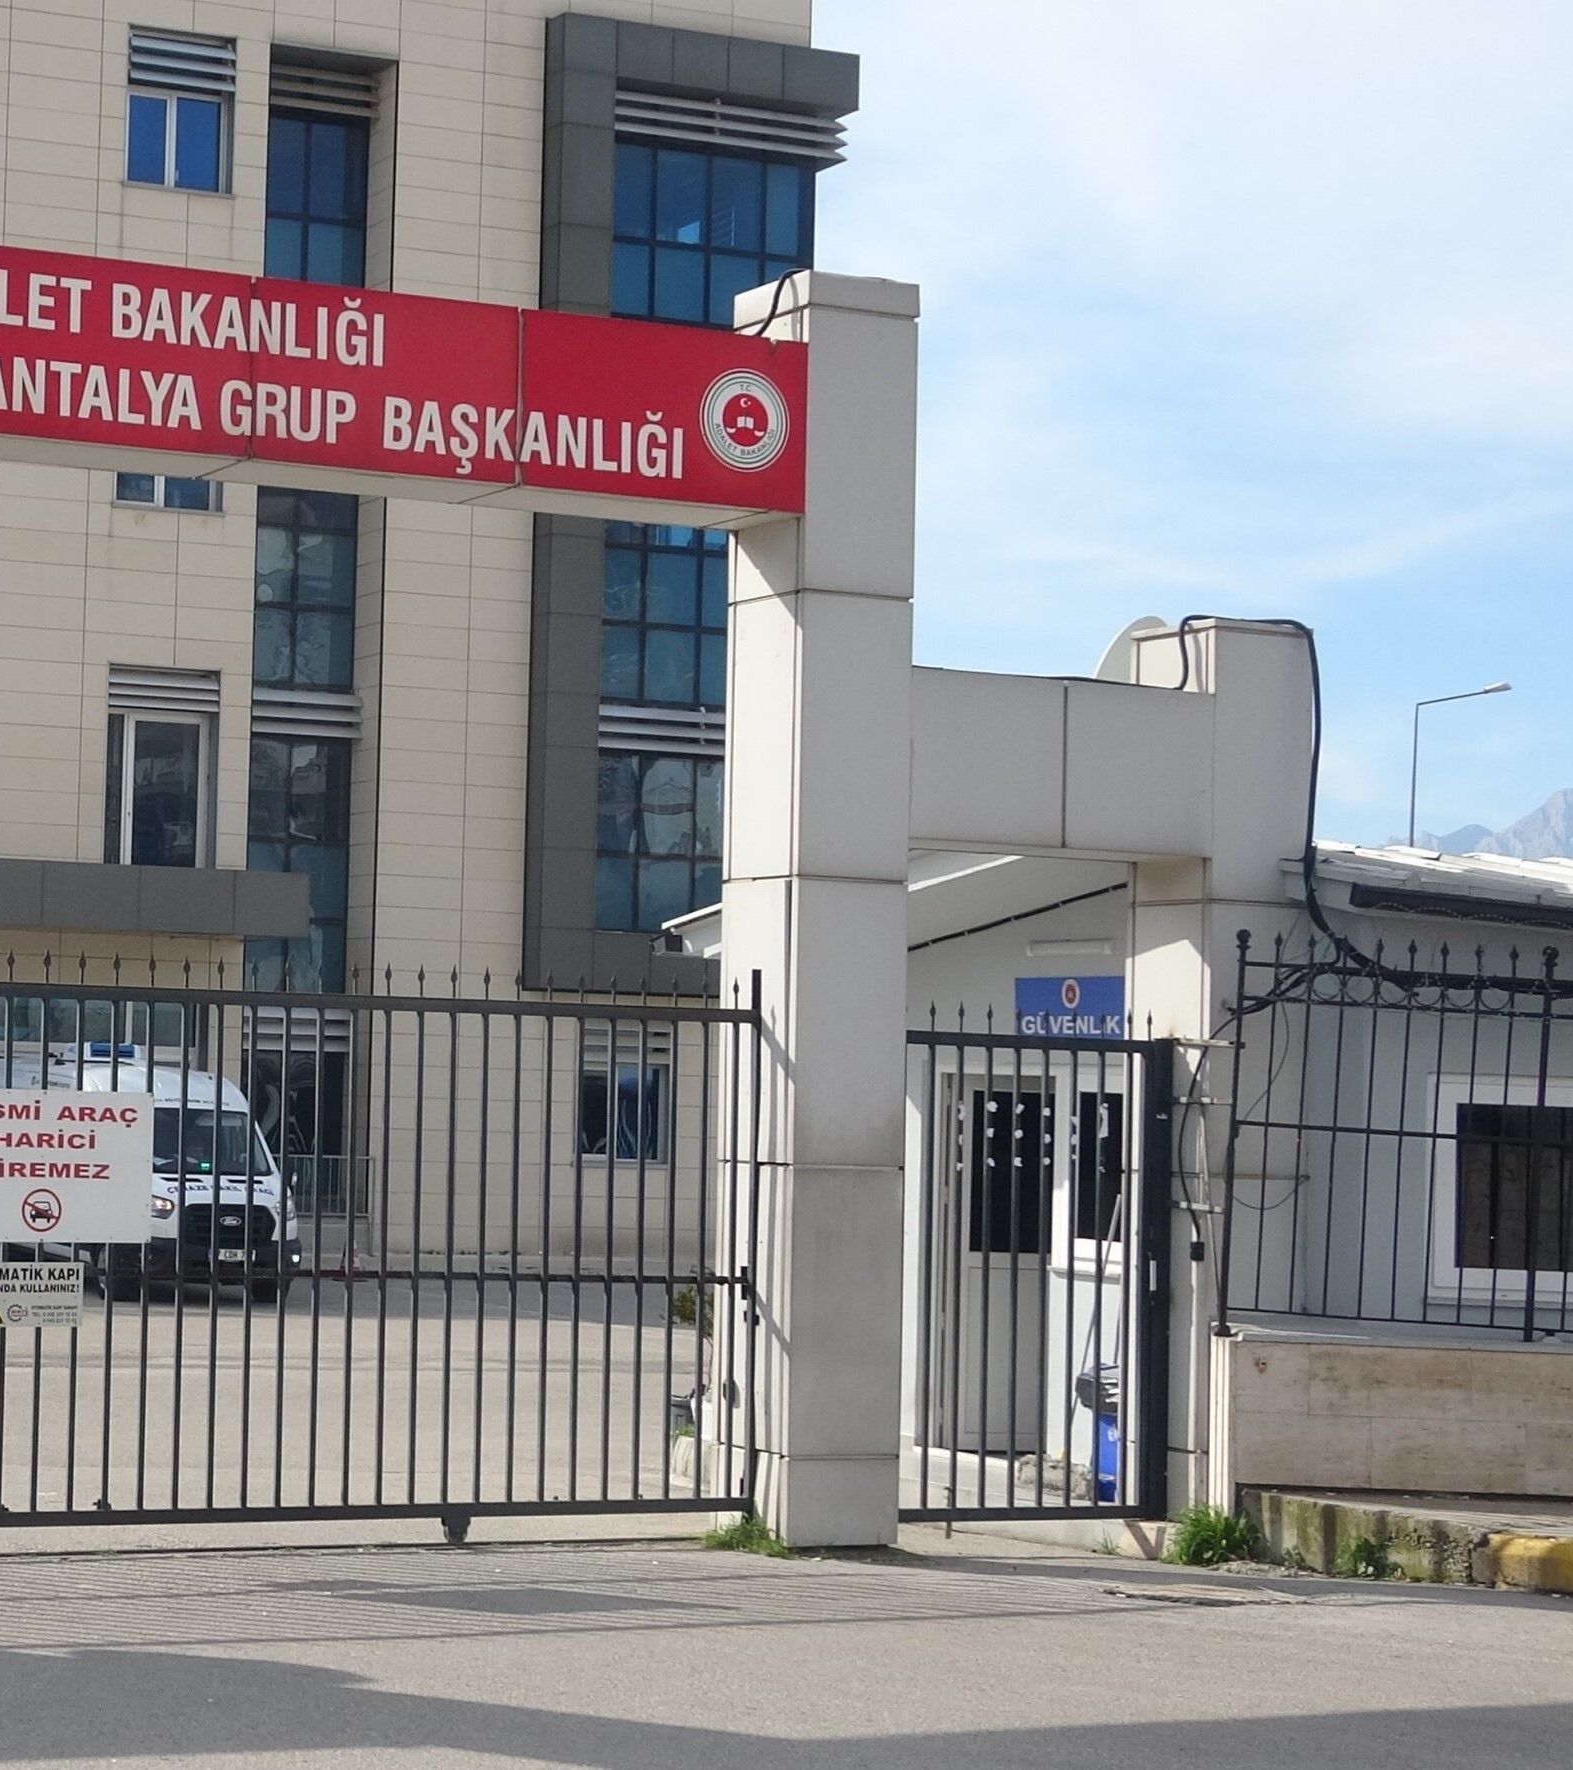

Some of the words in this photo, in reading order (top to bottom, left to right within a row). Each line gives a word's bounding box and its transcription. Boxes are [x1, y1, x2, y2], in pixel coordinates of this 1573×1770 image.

[112, 284, 384, 367] BAKANLIĞI
[220, 379, 357, 444] GRUP
[383, 397, 684, 479] BAŞKANLIĞI
[1021, 1010, 1120, 1034] GÜVENLK
[56, 1106, 138, 1128] ARAÇ
[48, 1267, 80, 1281] KAPI
